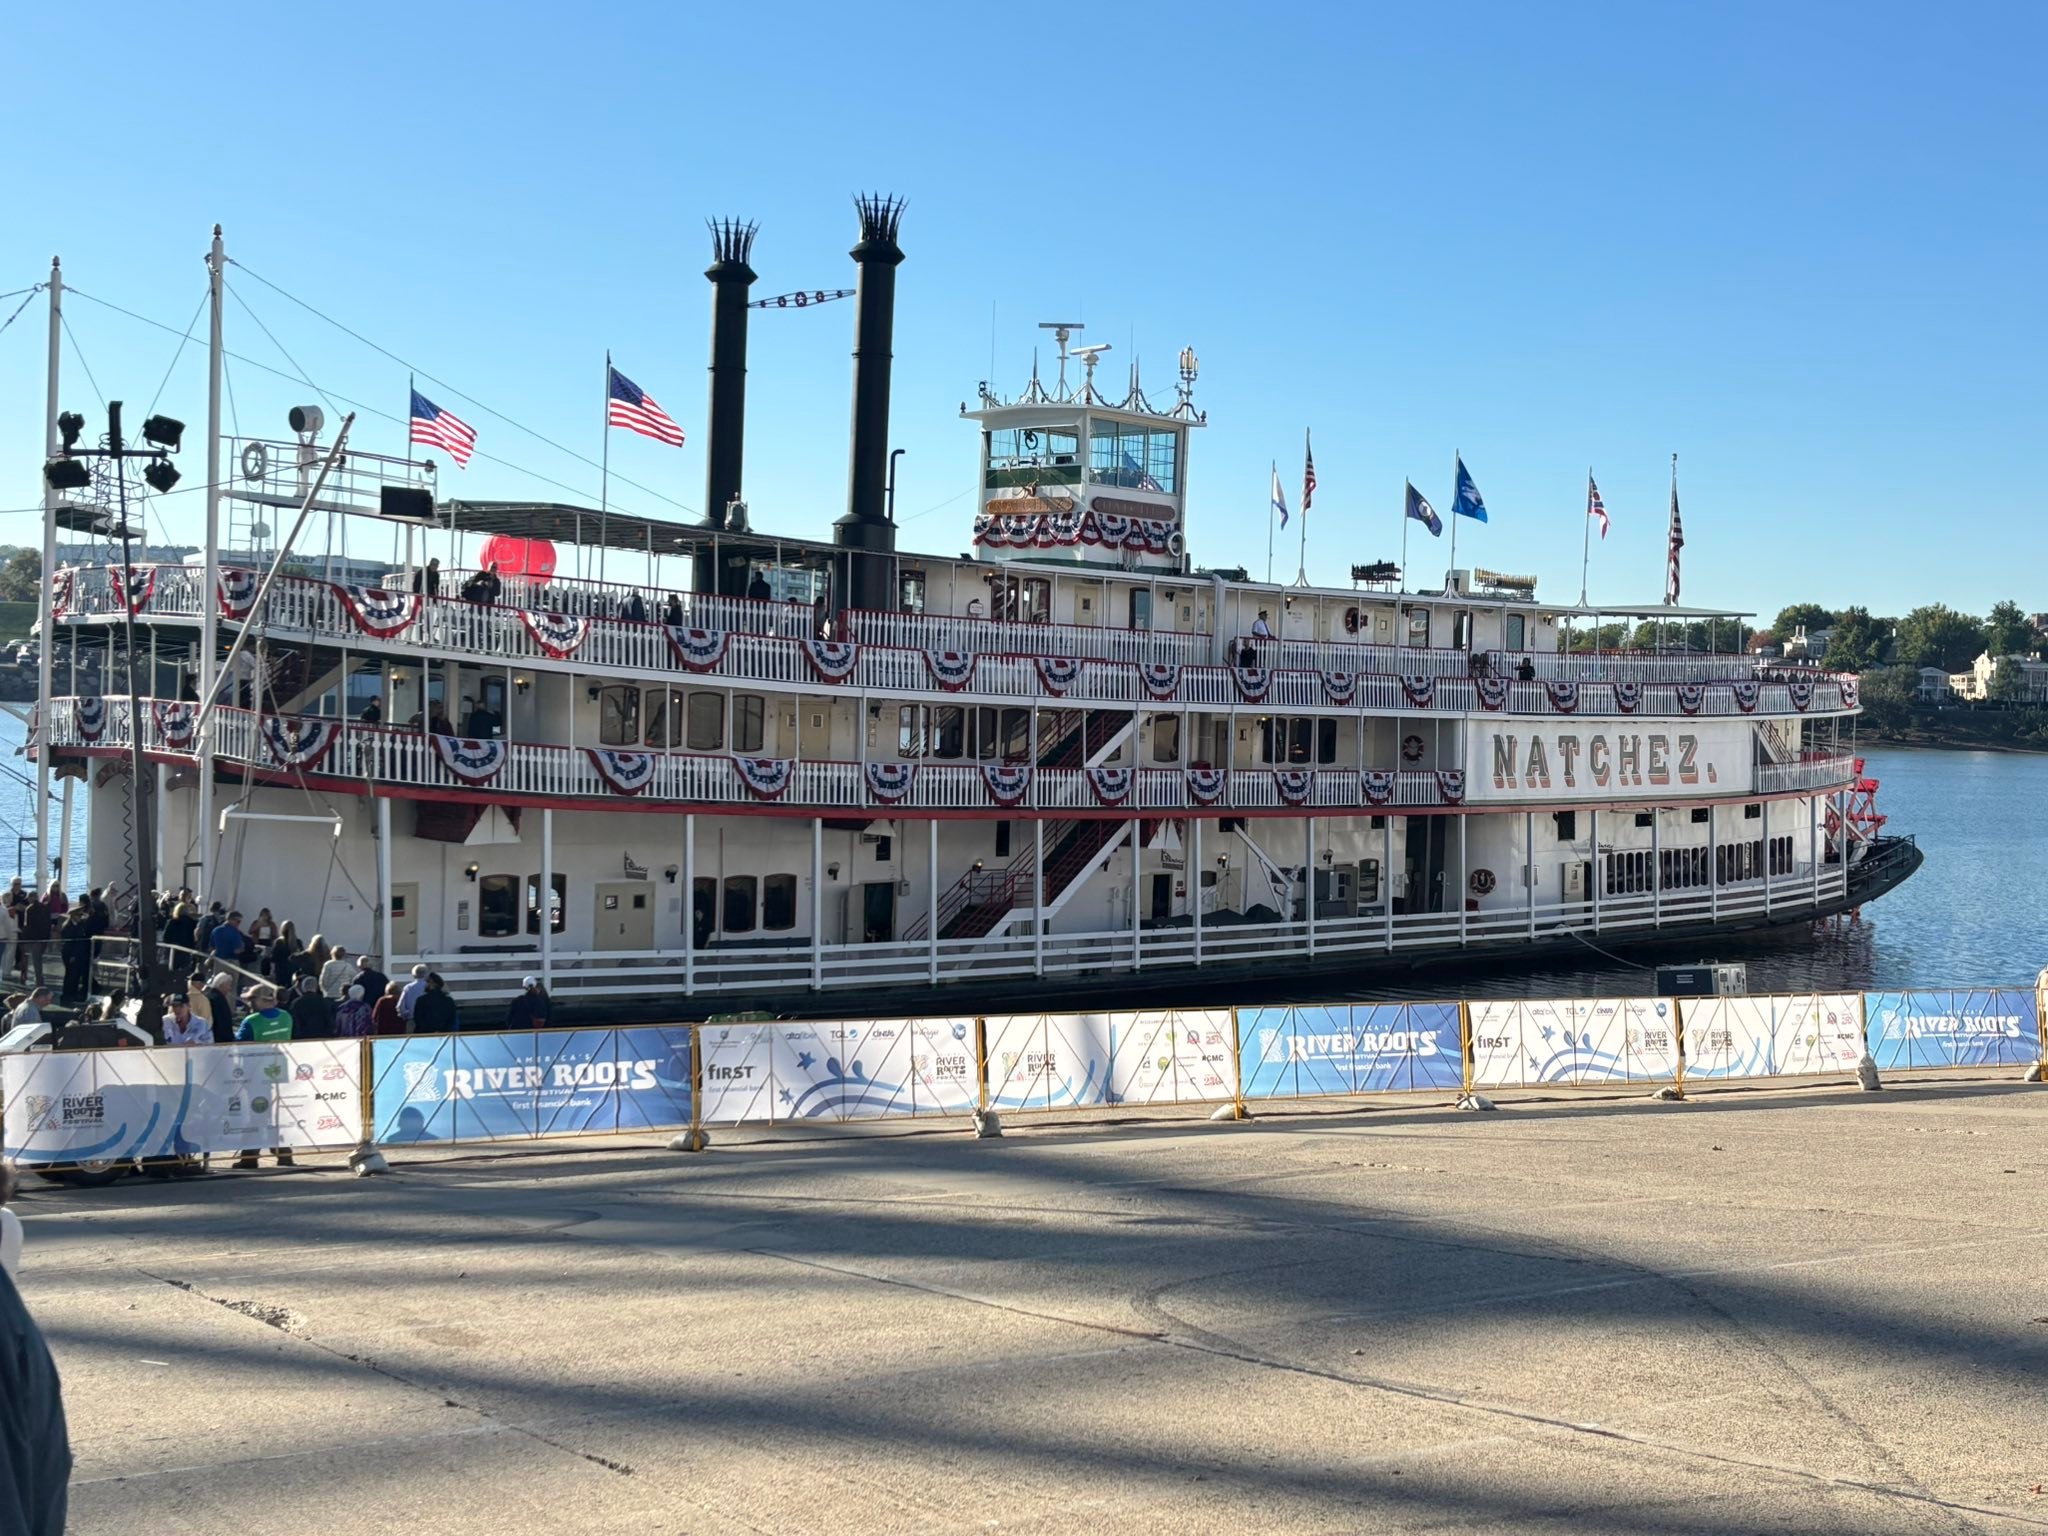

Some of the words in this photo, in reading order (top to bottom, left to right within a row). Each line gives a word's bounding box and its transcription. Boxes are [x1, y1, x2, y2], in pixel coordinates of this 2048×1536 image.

[1493, 735, 1717, 789] NATCHEZ.
[1644, 1031, 1667, 1039] RIVER
[1904, 1016, 1959, 1038] RIVER
[1963, 1015, 2019, 1037] ROOTS
[1287, 1033, 1356, 1062] RIVER
[1363, 1030, 1438, 1056] ROOTS
[936, 1056, 966, 1065] RIVER
[443, 1066, 544, 1101] RIVER
[552, 1059, 658, 1090] ROOTS
[62, 1096, 104, 1108] RIVER
[62, 1107, 104, 1119] ROOTS
